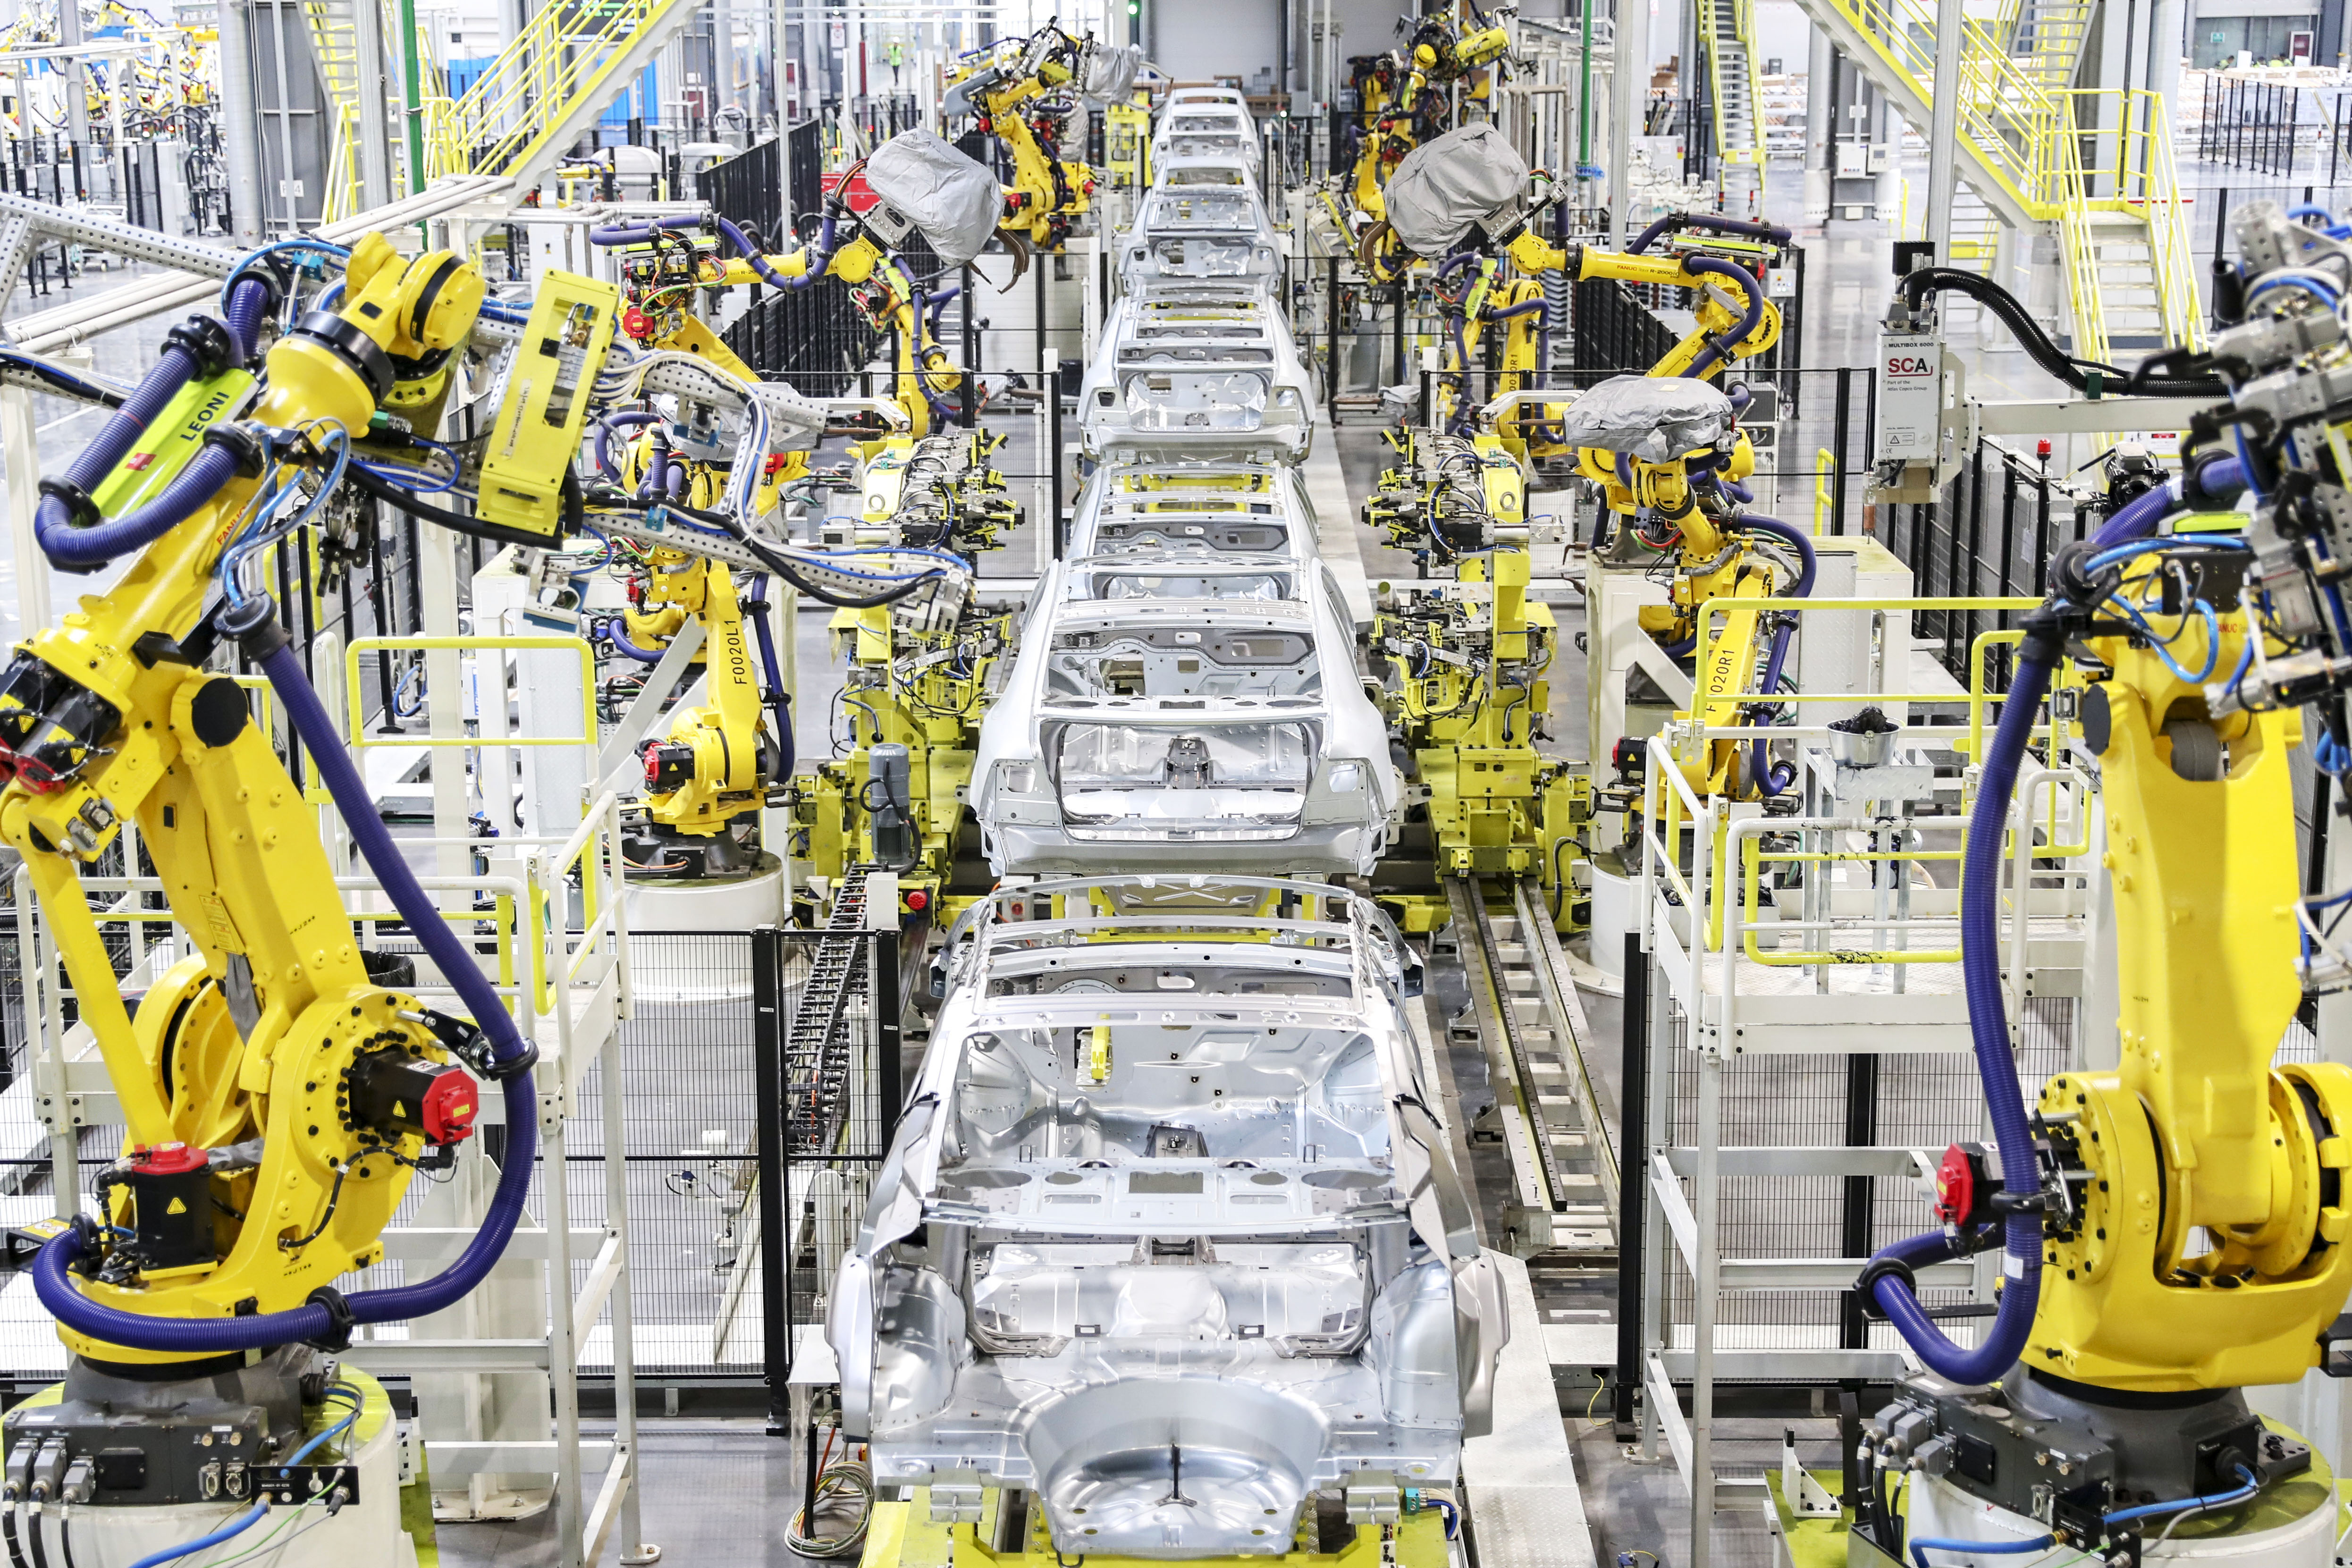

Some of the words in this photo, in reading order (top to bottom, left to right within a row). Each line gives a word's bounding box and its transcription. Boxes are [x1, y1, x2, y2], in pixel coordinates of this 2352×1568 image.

[1509, 354, 1518, 391] 0030R1
[1888, 357, 1928, 373] SCA
[179, 391, 229, 442] LEONI
[2217, 623, 2238, 633] ANUC
[724, 621, 747, 684] F0020L1
[1706, 650, 1735, 712] F020R1
